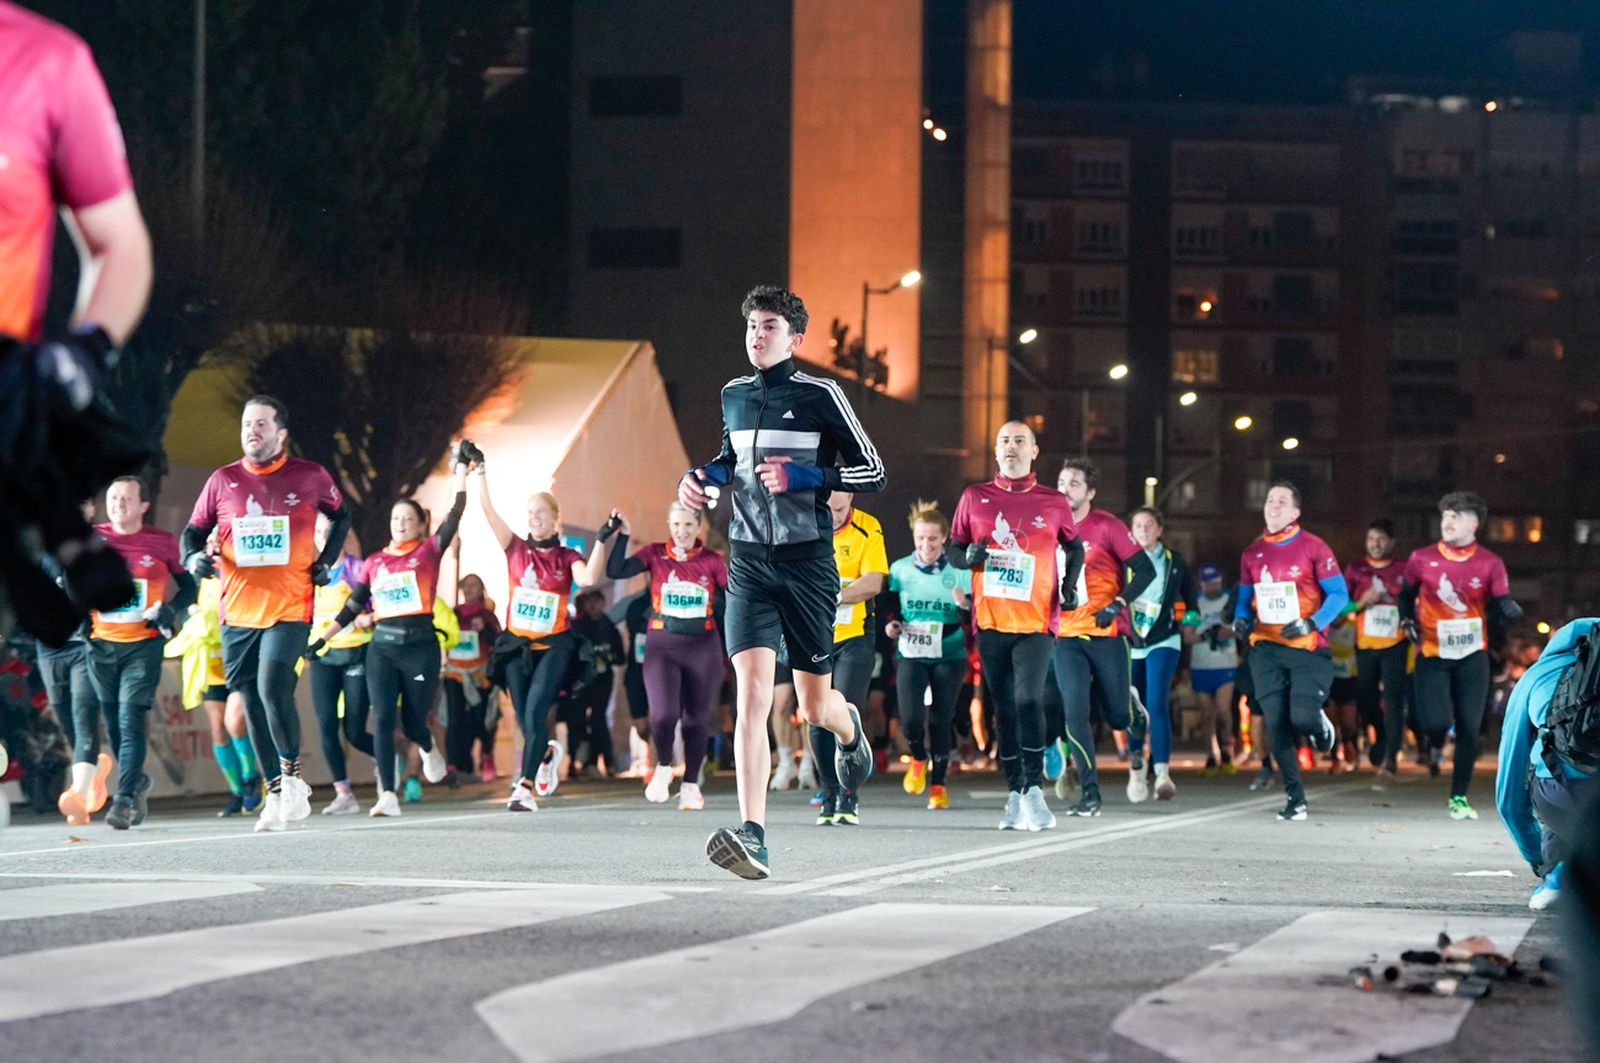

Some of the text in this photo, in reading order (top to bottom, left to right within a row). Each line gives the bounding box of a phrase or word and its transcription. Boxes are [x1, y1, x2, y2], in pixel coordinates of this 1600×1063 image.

[241, 534, 282, 549] 13342
[993, 566, 1024, 583] 283
[907, 598, 951, 611] serás
